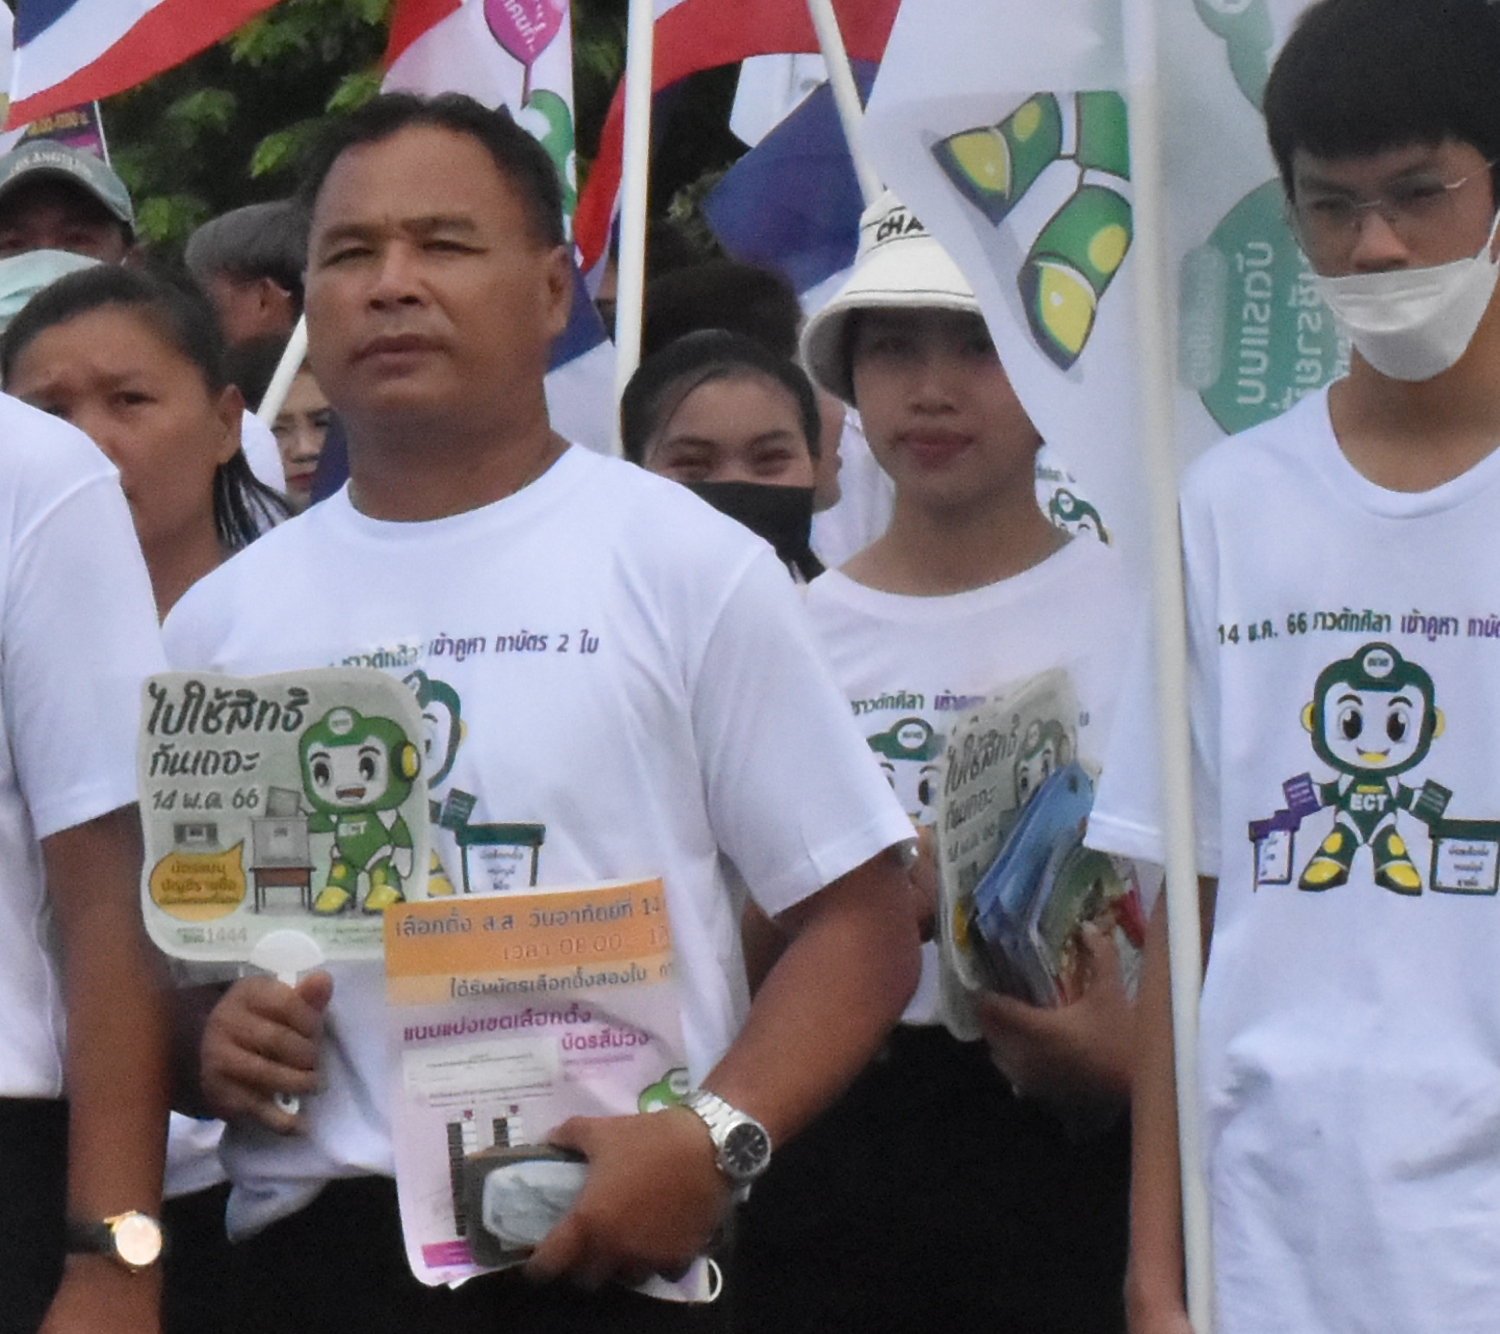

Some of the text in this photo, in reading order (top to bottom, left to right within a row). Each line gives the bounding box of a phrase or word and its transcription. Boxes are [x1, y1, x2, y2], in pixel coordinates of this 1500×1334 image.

[1217, 623, 1239, 645] 14
[1286, 611, 1307, 635] 66
[1401, 608, 1458, 642] เข้าคูหา
[428, 631, 487, 663] เข้าคูหา
[495, 629, 550, 653] กาบัตร
[557, 633, 570, 653] 2
[579, 628, 600, 654] ใบ
[147, 679, 310, 736] ไปใช้สิทธิ
[151, 789, 178, 810] 14
[231, 787, 260, 809] 66
[1350, 792, 1388, 813] ECT
